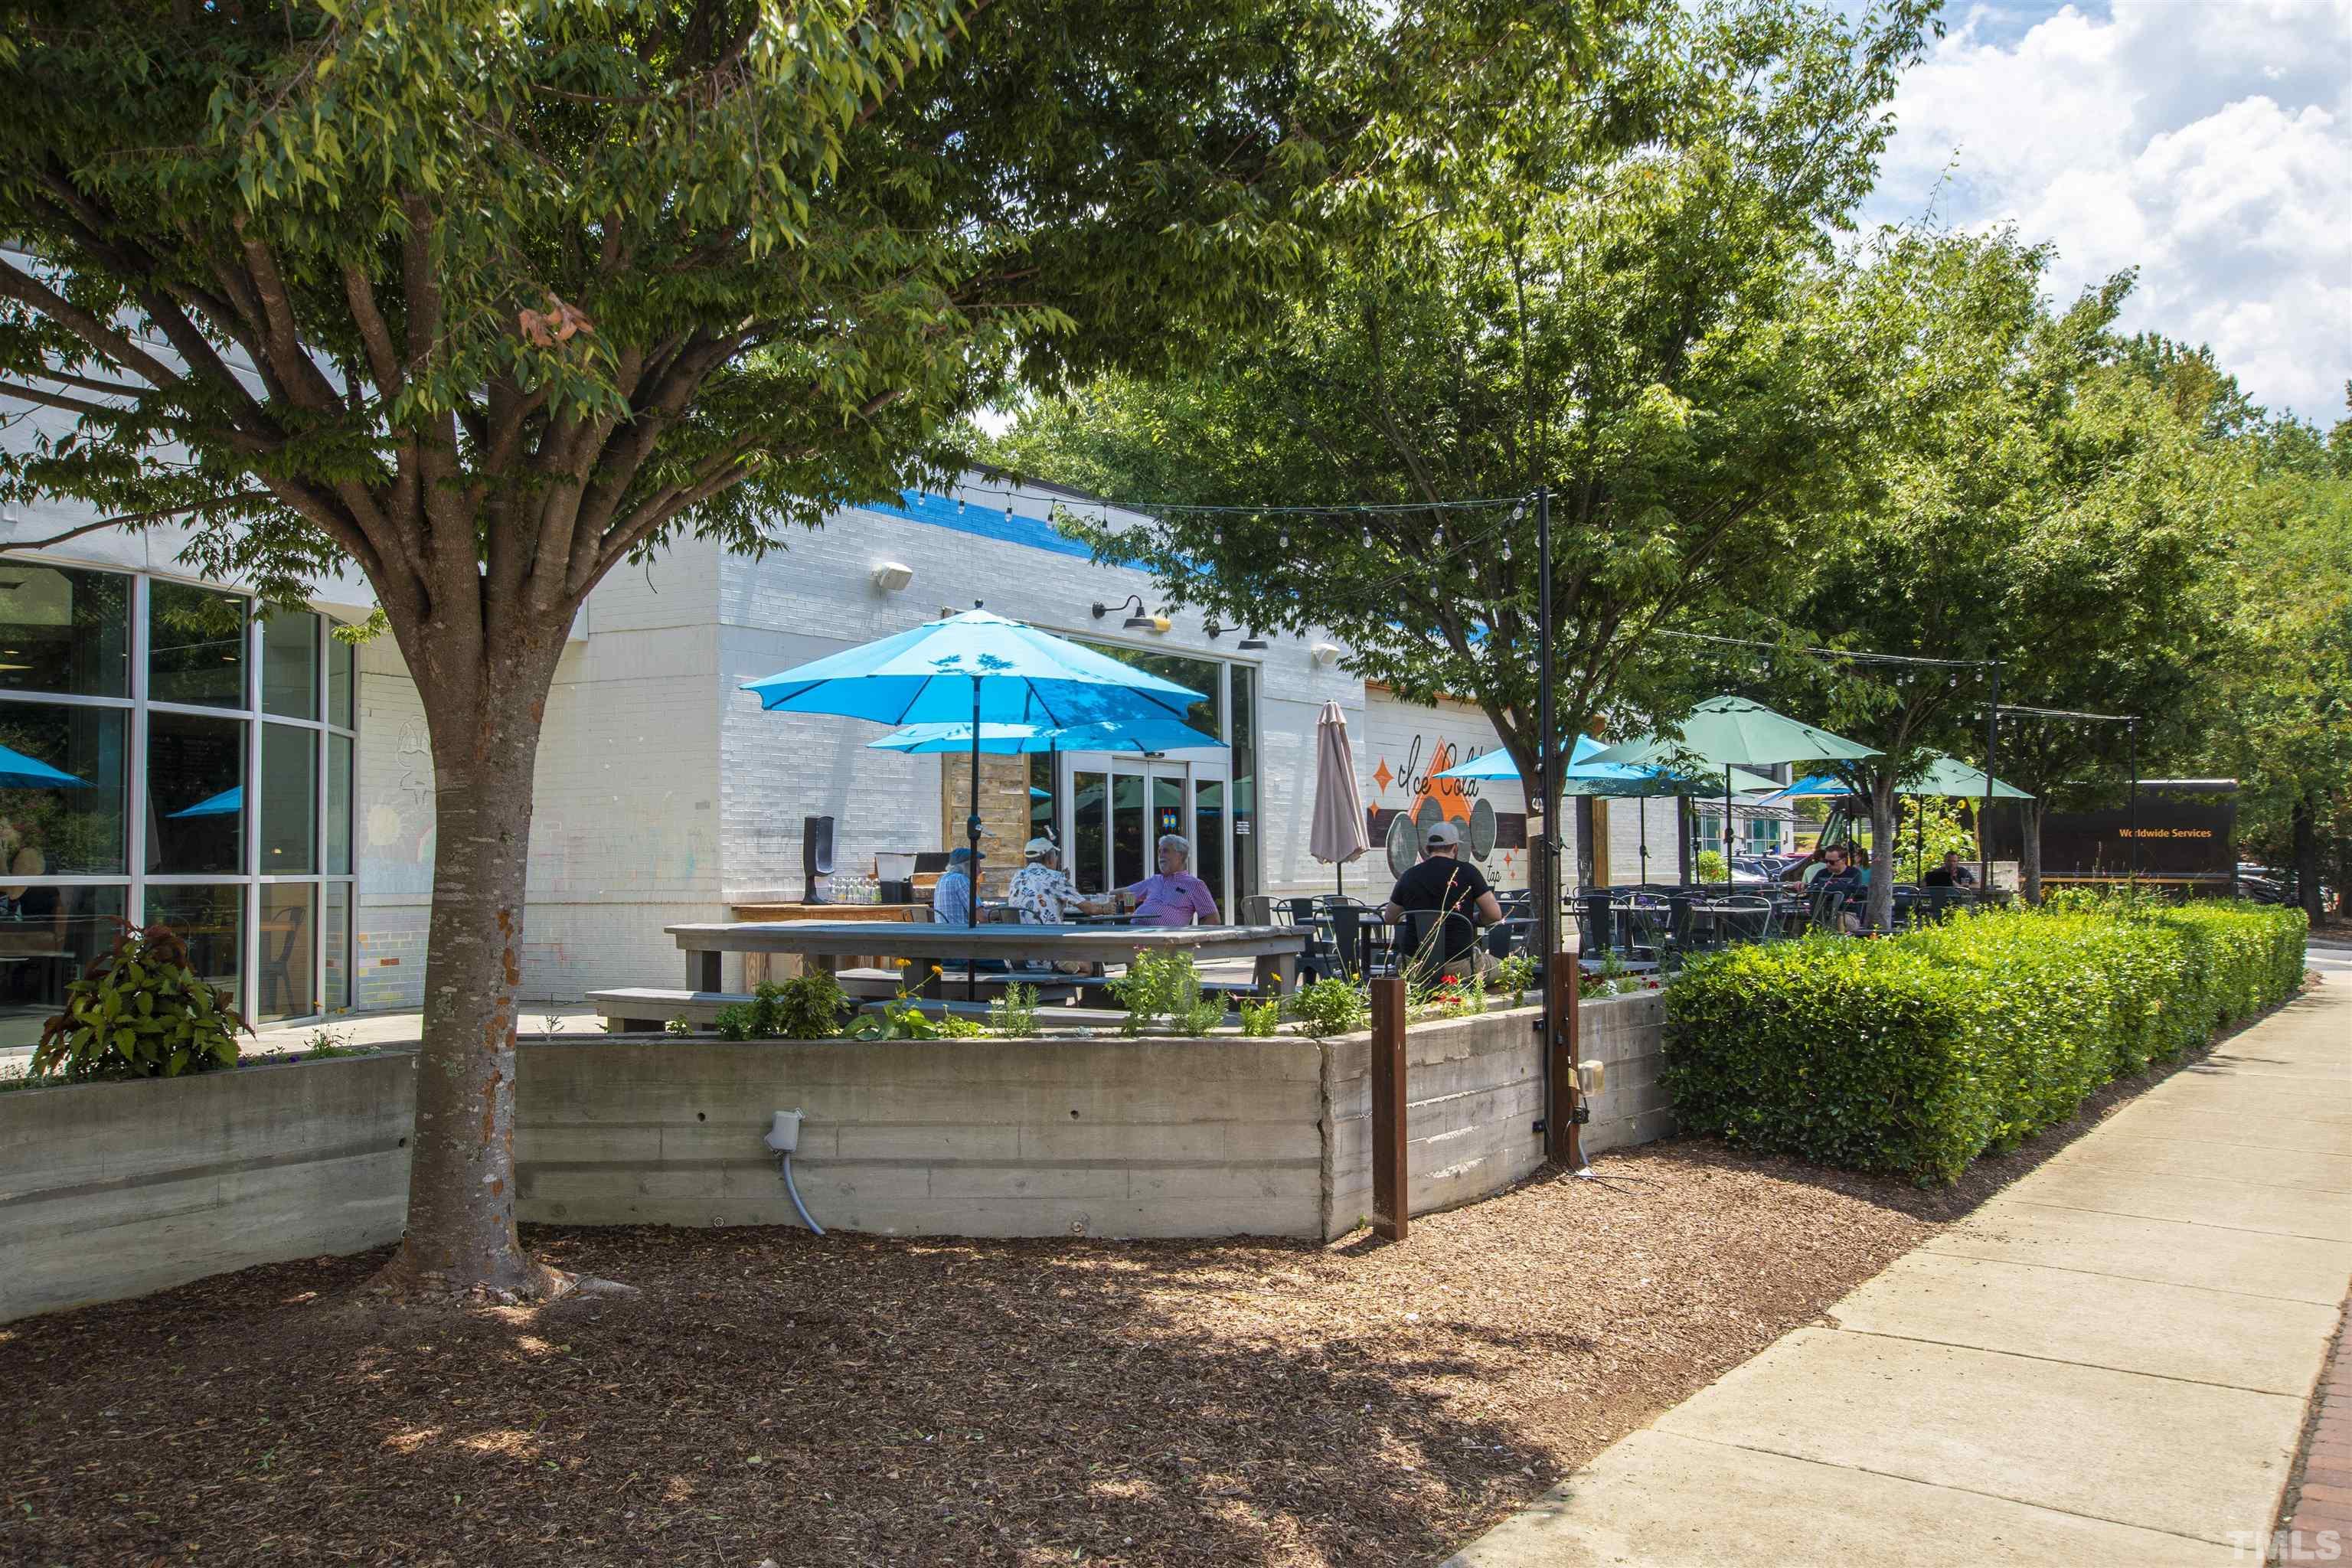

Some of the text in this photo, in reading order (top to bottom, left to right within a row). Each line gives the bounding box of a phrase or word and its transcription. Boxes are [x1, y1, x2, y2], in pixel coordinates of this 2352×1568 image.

[1397, 734, 1432, 797] Ice
[2171, 828, 2212, 838] Services
[1487, 857, 1502, 886] tap
